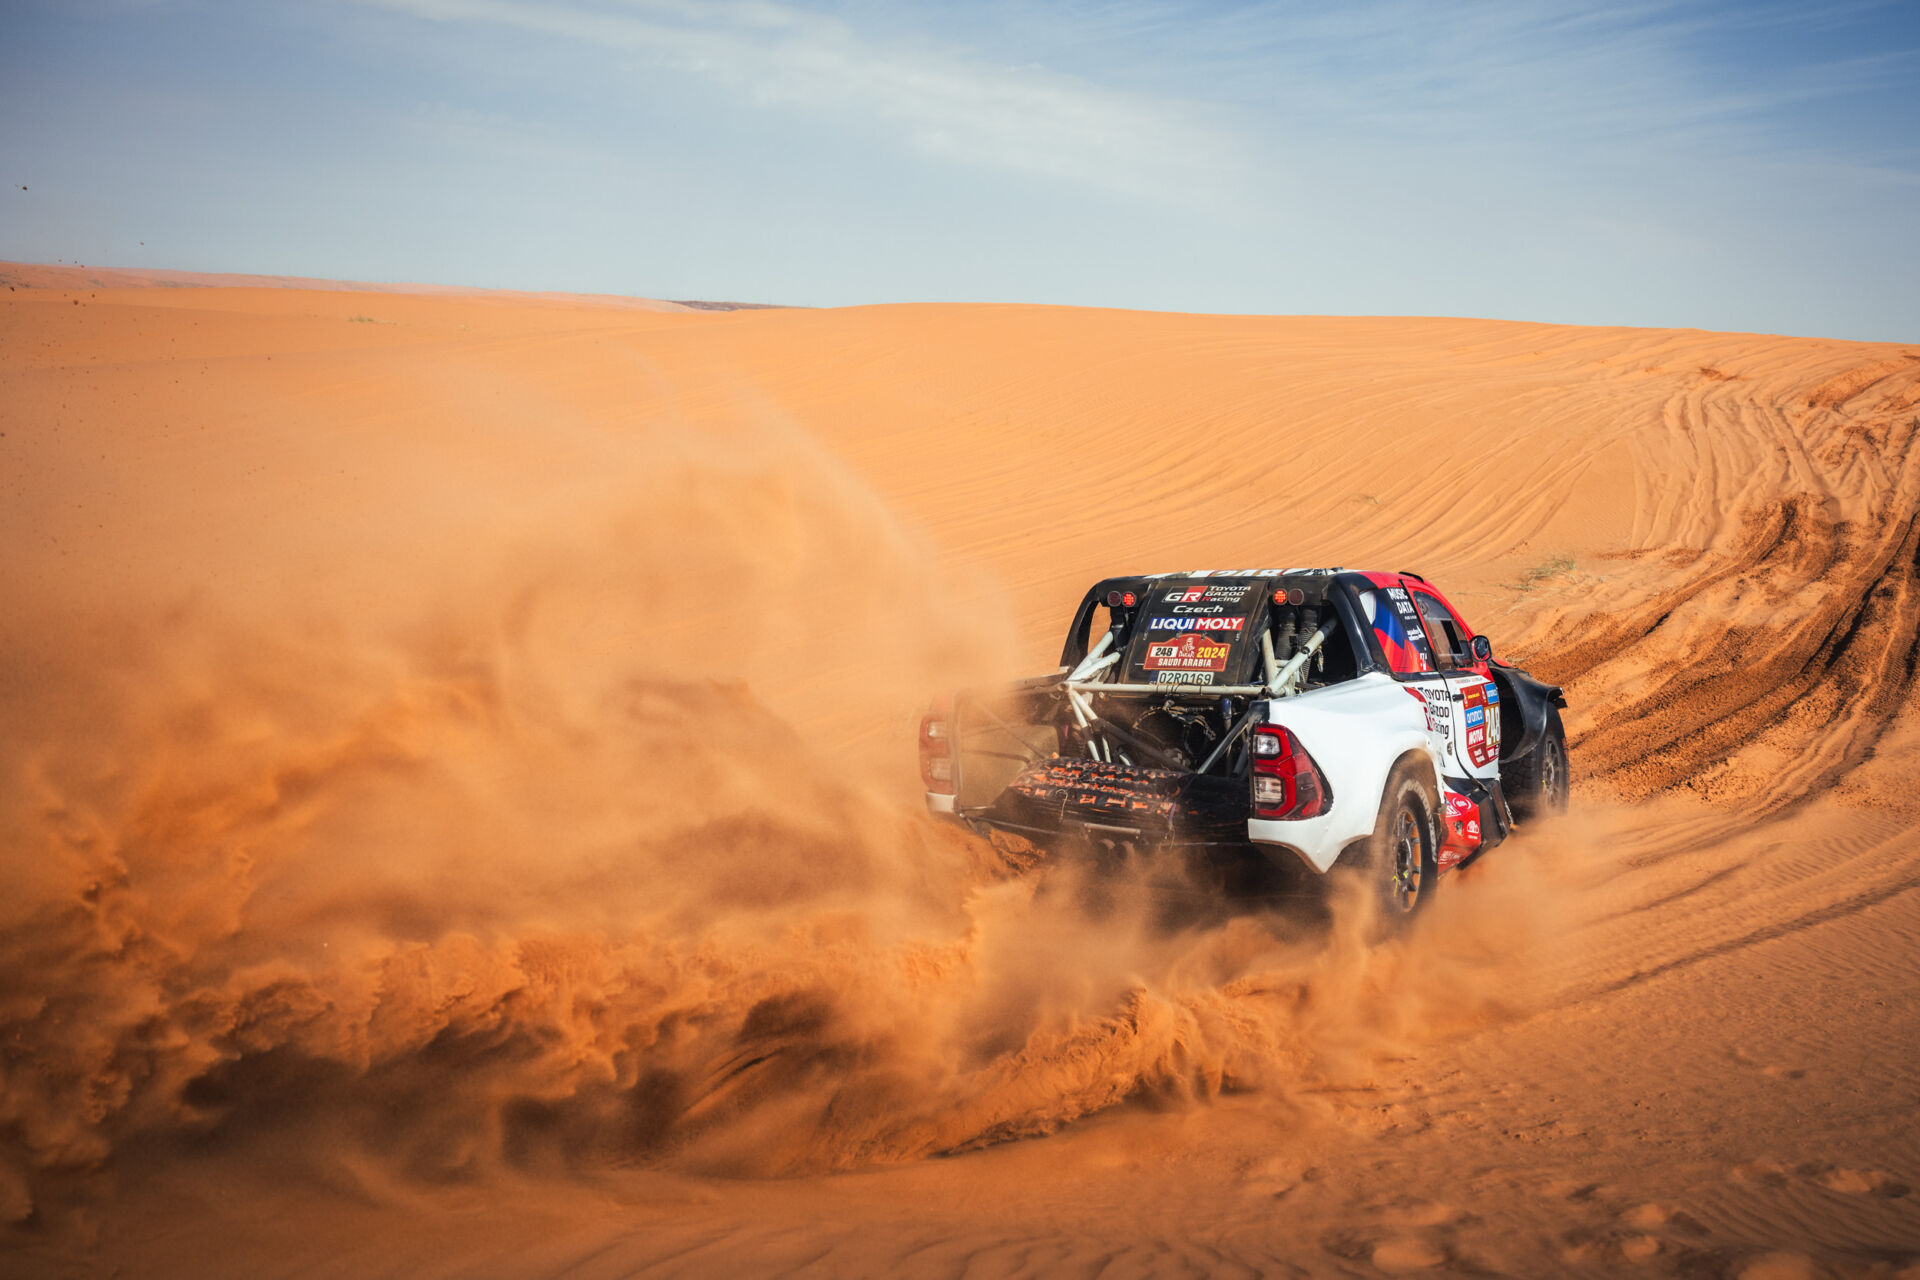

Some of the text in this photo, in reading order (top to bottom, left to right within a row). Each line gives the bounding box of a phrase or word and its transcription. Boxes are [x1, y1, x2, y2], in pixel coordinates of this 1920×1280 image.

[1164, 592, 1202, 602] GR
[1386, 588, 1409, 600] MUSIC
[1173, 605, 1224, 613] Czech
[1396, 602, 1415, 614] DATA
[1150, 618, 1243, 630] LIQUI MOLY
[1155, 647, 1173, 657] 248
[1196, 647, 1226, 659] 2024
[1157, 658, 1212, 667] SAUDI ARABIA
[1417, 687, 1451, 702] TOYOTA
[1466, 709, 1483, 725] aramco
[1485, 705, 1500, 747] 248
[1468, 728, 1484, 746] MOTUL
